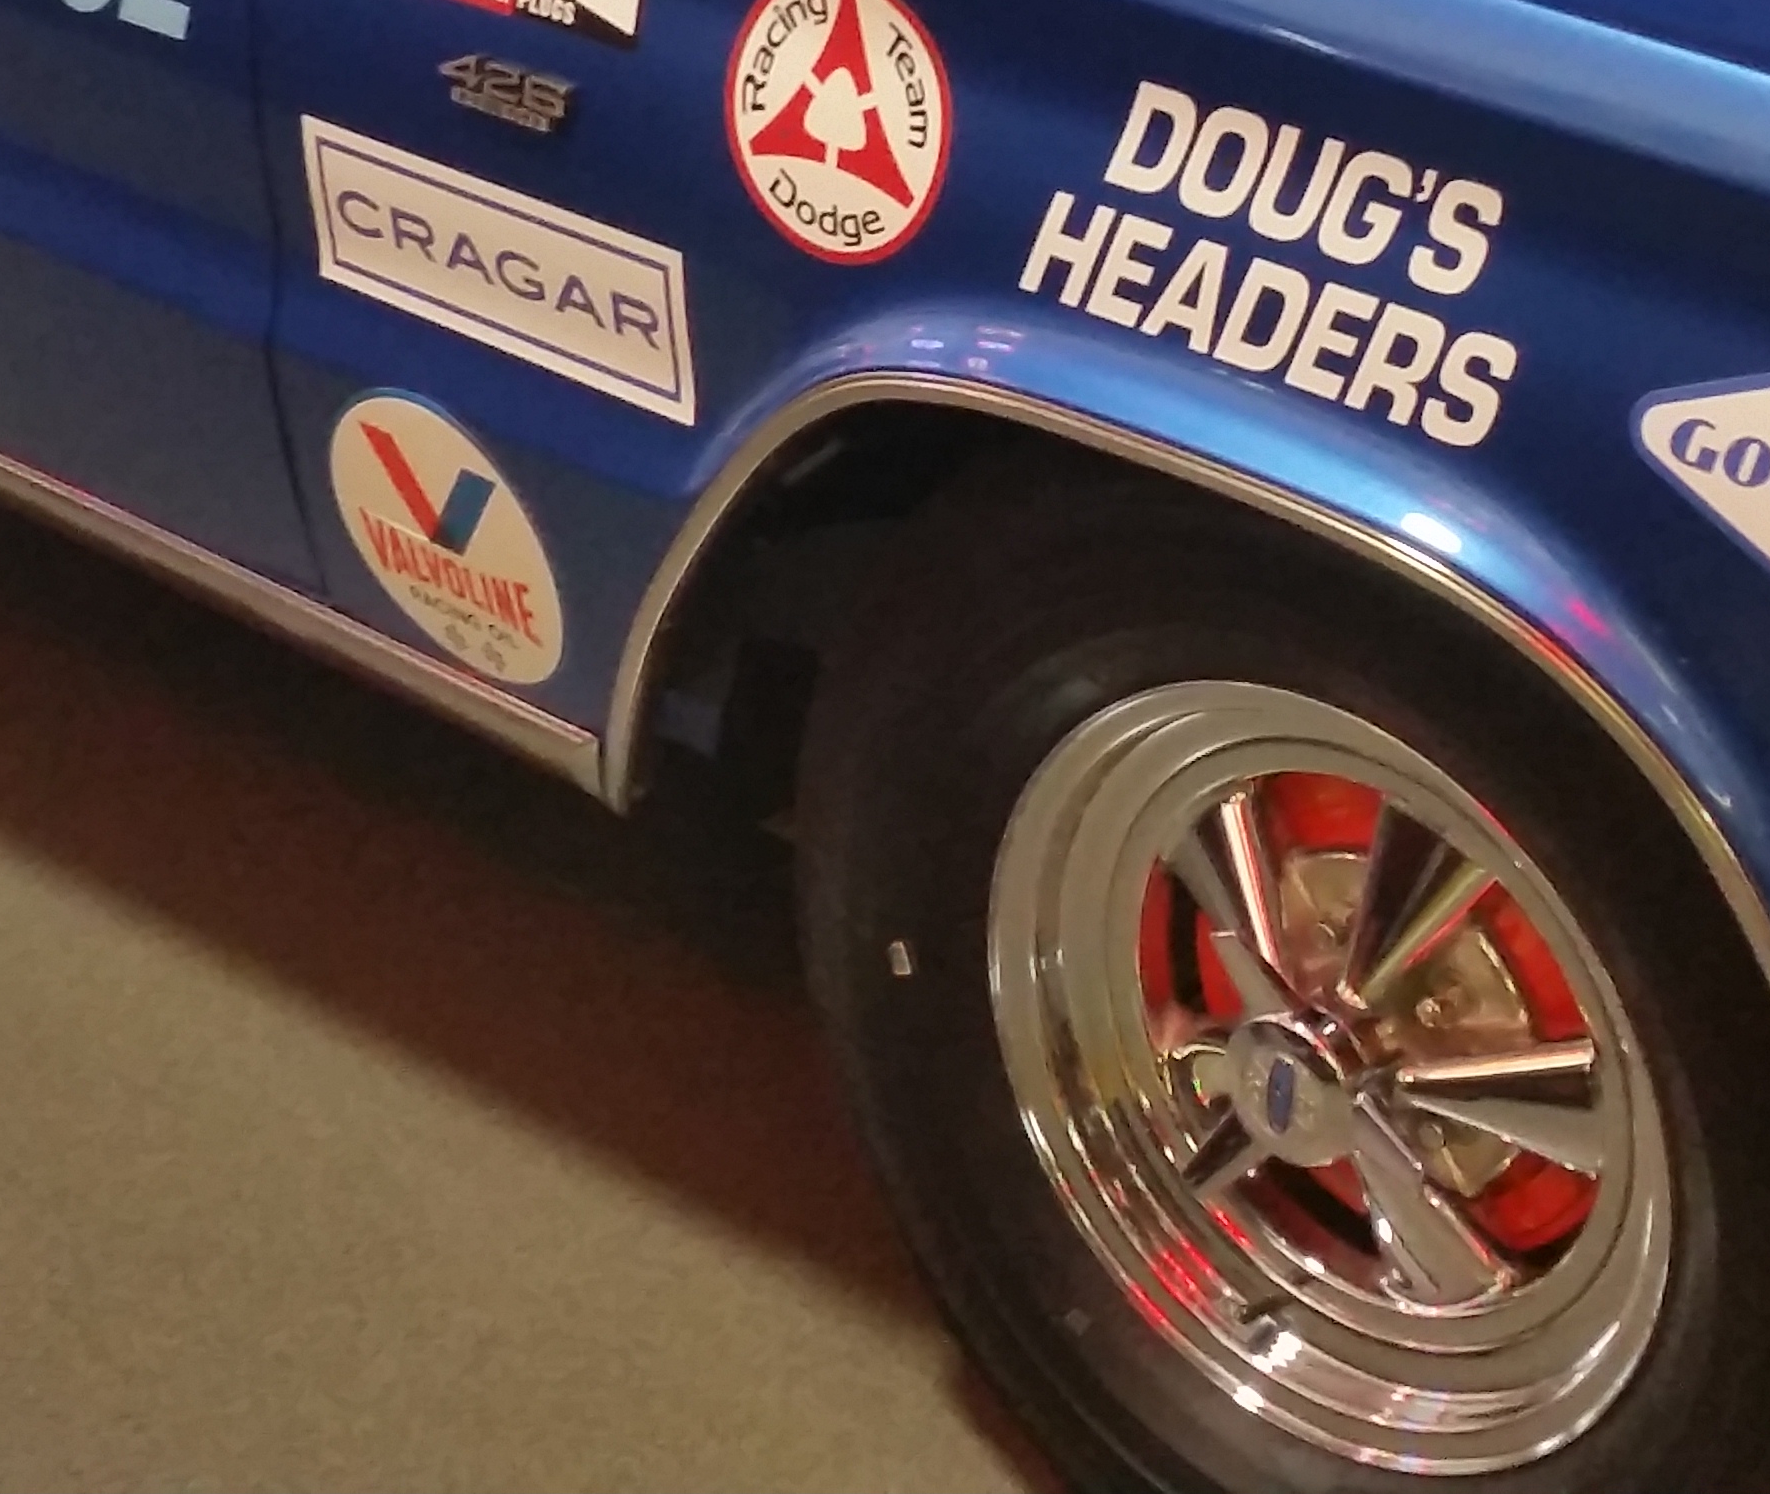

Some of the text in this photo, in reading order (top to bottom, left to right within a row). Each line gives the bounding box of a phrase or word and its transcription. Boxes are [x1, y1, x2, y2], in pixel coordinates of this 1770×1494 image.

[438, 54, 575, 118] 426
[885, 21, 929, 150] Team
[768, 167, 886, 248] Dodge
[1102, 79, 1505, 296] DOUG'S
[335, 188, 660, 352] CRAGAR
[1017, 188, 1520, 448] HEADERS
[358, 505, 544, 649] VALVOLINE
